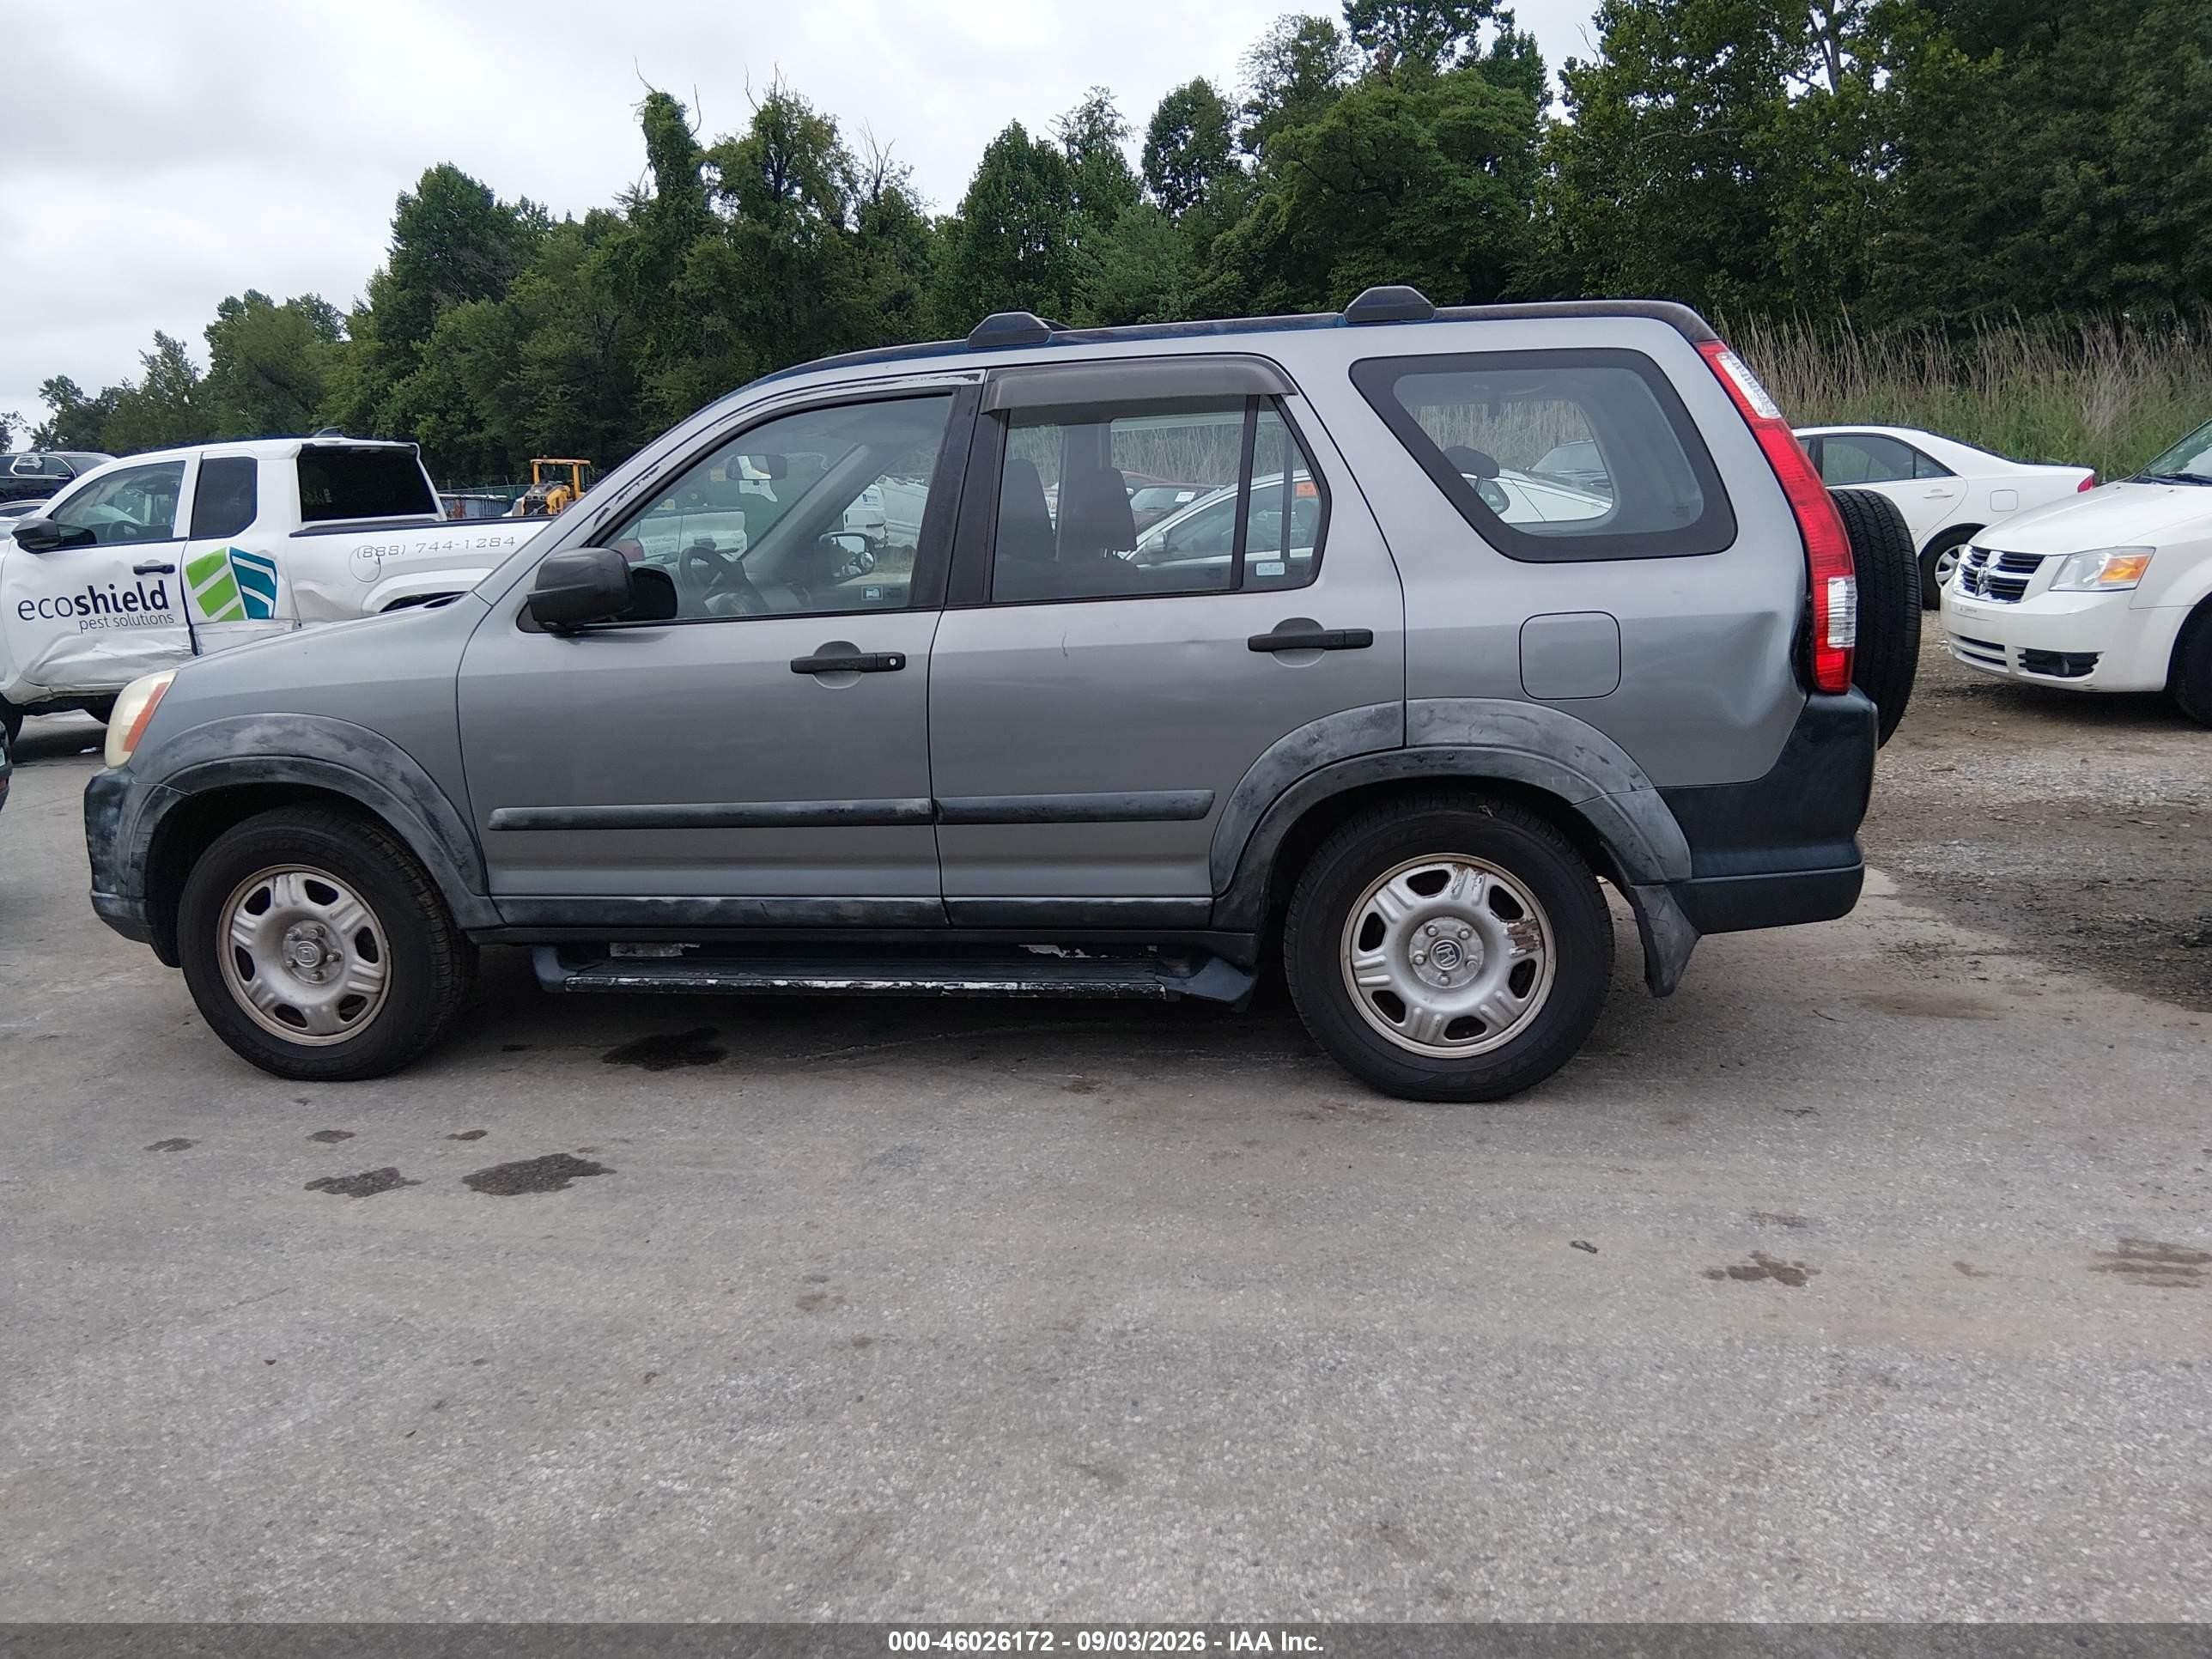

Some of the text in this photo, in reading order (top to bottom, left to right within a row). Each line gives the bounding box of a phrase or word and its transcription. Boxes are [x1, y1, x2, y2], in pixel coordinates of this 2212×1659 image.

[356, 537, 516, 560] (888) 744-1284
[17, 580, 170, 622] ecoshield
[79, 612, 175, 634] pest solutions
